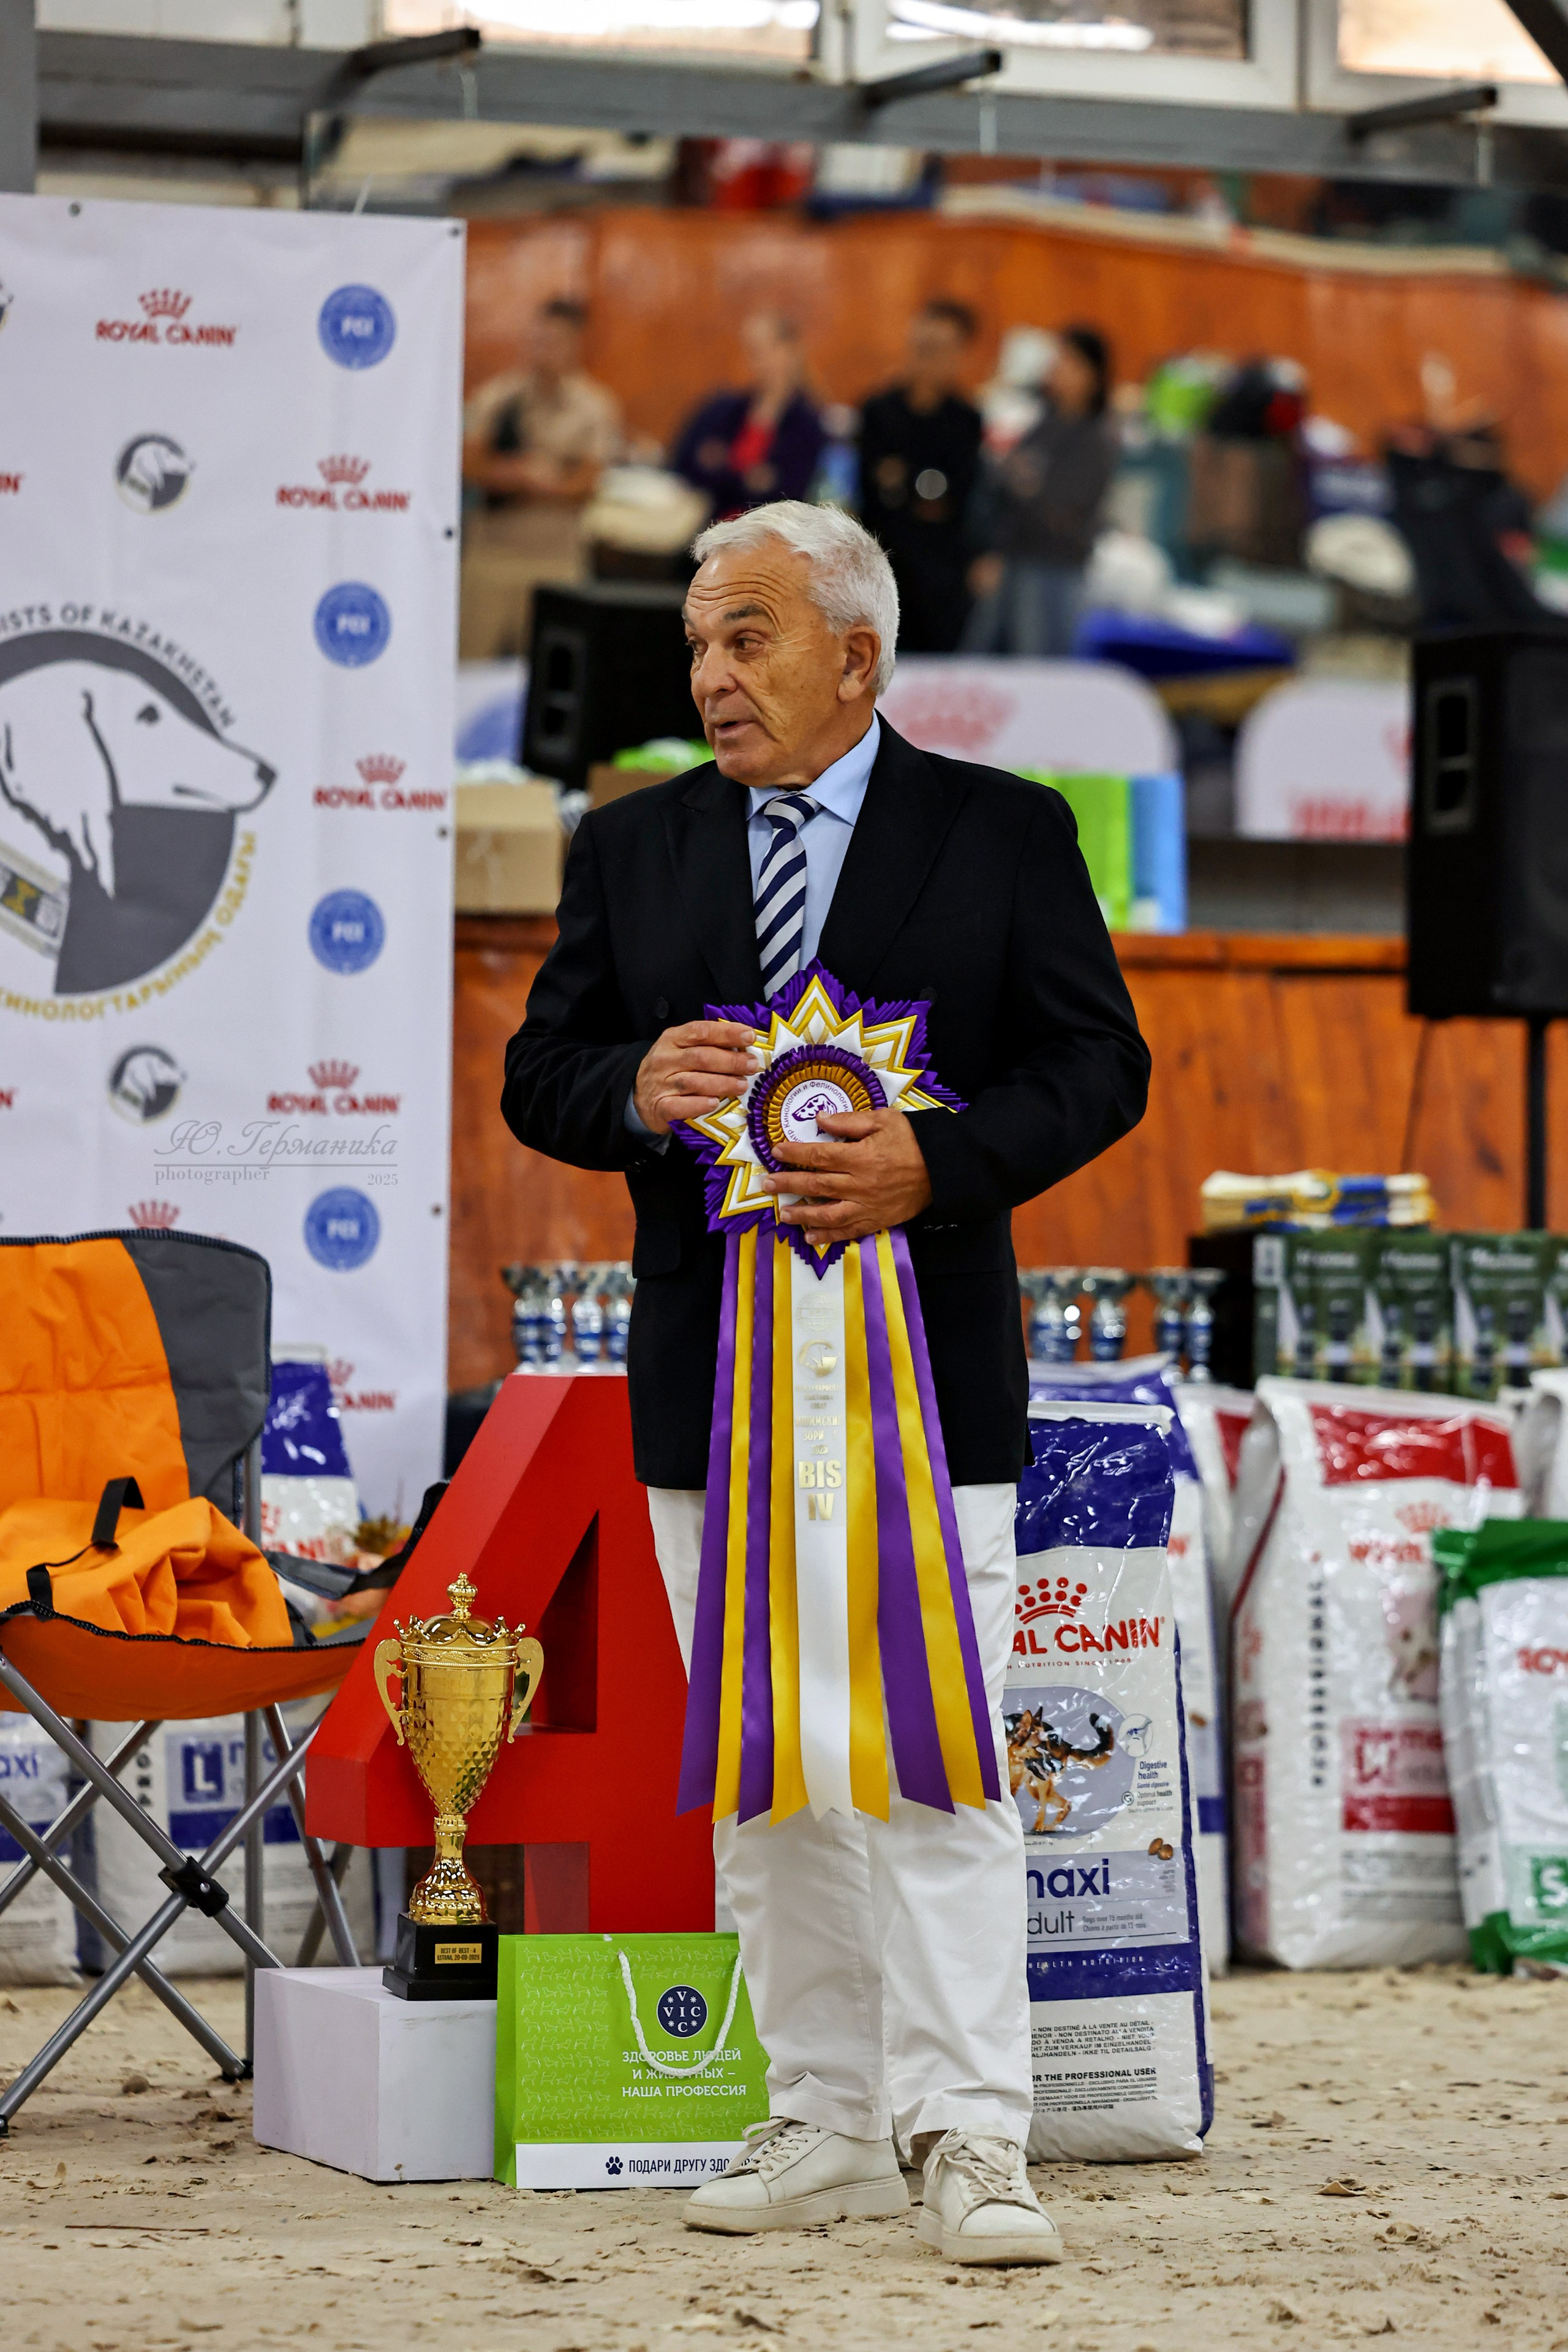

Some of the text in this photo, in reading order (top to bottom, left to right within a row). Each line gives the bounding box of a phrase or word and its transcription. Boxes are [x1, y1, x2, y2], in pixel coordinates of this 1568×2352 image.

[783, 1088, 802, 1128] Кинологии
[803, 1430, 824, 1441] ЗОРИ
[798, 1459, 843, 1489] BIS
[808, 1492, 835, 1521] IV
[1054, 1616, 1159, 1653] CANIN
[1140, 1760, 1167, 1771] Digestive
[1138, 1771, 1158, 1779] health
[1027, 1858, 1110, 1899] axi
[1027, 1910, 1075, 1935] dult
[1082, 1956, 1143, 1966] NUTRITION
[632, 2069, 643, 2079] И
[1065, 2070, 1131, 2080] PROFESSIONAL
[1134, 2067, 1156, 2076] USER
[622, 2084, 747, 2097] НАША ПРОФЕССИЯ
[628, 2160, 671, 2174] ПОДАРИ
[674, 2158, 707, 2174] ДРУГУ
